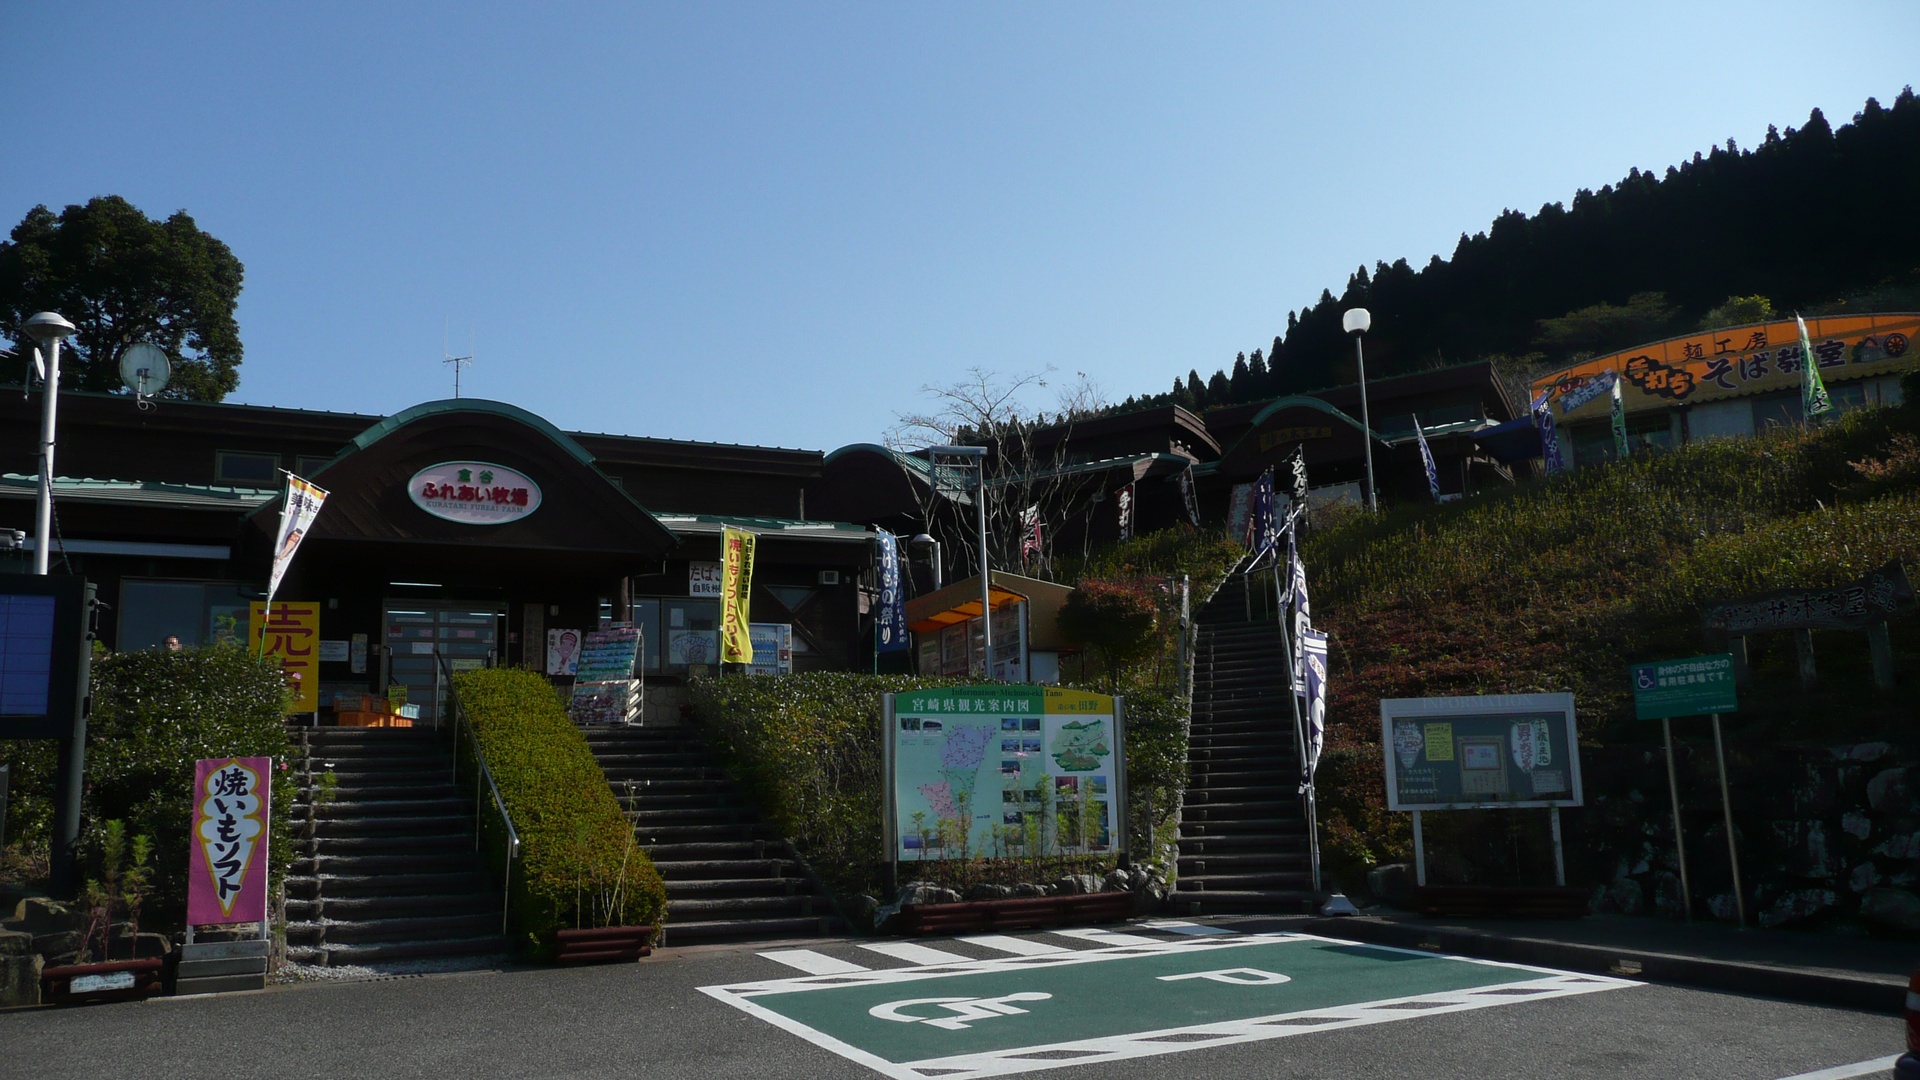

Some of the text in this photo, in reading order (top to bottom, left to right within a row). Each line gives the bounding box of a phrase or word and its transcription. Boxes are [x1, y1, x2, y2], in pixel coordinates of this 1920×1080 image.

[1701, 339, 1847, 389] そば教室
[1628, 358, 1690, 397] 手打ち
[422, 482, 529, 506] ふれあい牧場
[426, 501, 467, 510] KURATANI
[471, 504, 499, 512] FUREAI
[881, 538, 893, 645] つけもの祭り
[1658, 660, 1729, 676] 身体の不自由な方の
[1658, 672, 1731, 687] 専用駐車場です。
[1045, 688, 1063, 698] Tano
[912, 699, 1030, 712] 宮崎県観光案内図
[1078, 700, 1098, 711] 田野
[1423, 694, 1533, 710] INFORMATION
[214, 768, 248, 900] 焼いもソフト
[1155, 967, 1291, 985] P
